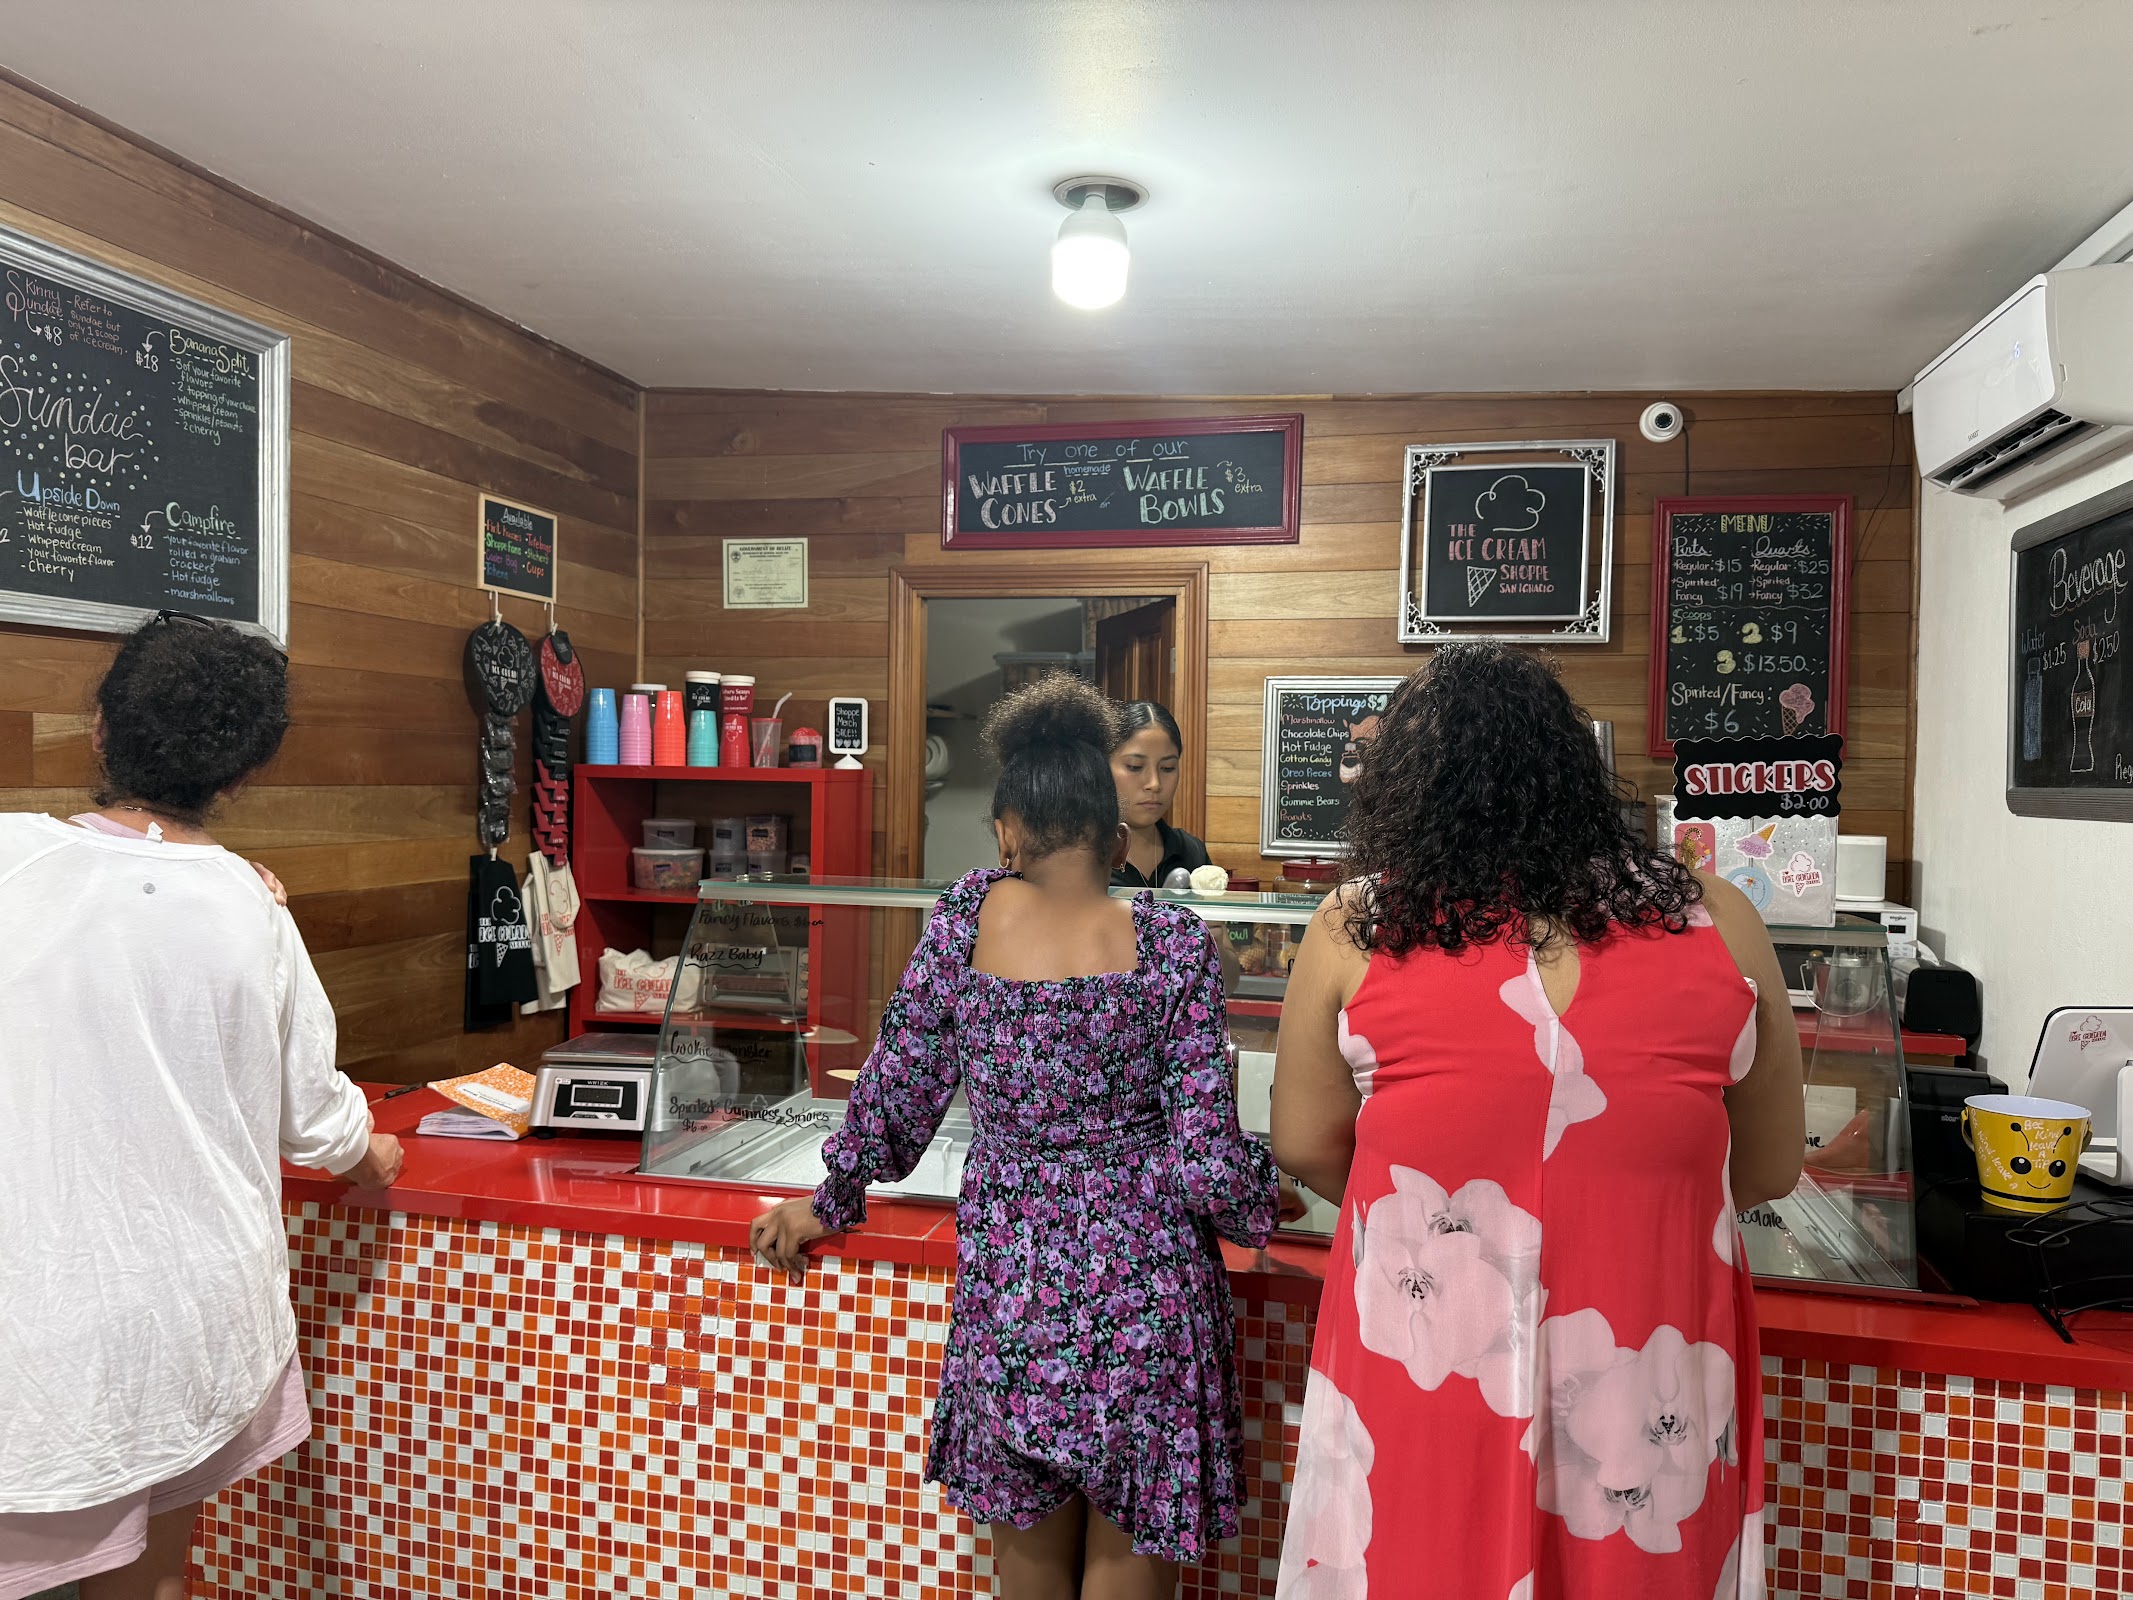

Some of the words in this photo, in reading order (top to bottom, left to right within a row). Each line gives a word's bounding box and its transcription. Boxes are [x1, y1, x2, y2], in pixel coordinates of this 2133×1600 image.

[75, 295, 101, 312] Refer
[103, 302, 113, 317] to
[107, 319, 121, 332] but
[44, 325, 62, 346] $8
[69, 331, 80, 341] of
[95, 331, 119, 343] scoop
[170, 329, 218, 356] Banana
[216, 345, 249, 374] Split
[136, 350, 159, 373] $18
[175, 357, 182, 370] 3
[183, 361, 193, 372] of
[193, 365, 210, 378] your
[210, 369, 241, 388] favorite
[181, 371, 214, 389] flavors
[0, 355, 144, 441] Sundae
[178, 382, 184, 392] 2
[187, 387, 218, 407] topping
[212, 405, 238, 419] cream
[184, 421, 191, 431] 2
[191, 423, 221, 446] cherry
[65, 432, 134, 476] bar
[1017, 443, 1047, 465] Try
[1065, 444, 1099, 459] one
[1116, 439, 1138, 458] of
[1152, 439, 1189, 457] our
[1064, 463, 1112, 476] homemade
[1224, 466, 1246, 482] $3
[18, 469, 83, 507] Upside
[86, 488, 121, 511] Down
[968, 470, 1058, 500] WAFFLE
[1123, 464, 1209, 492] WAFFLE
[1069, 480, 1084, 494] $2
[1235, 481, 1263, 495] extra
[1073, 493, 1098, 504] extra
[981, 498, 1058, 529] CONES
[1099, 500, 1111, 509] or
[1139, 488, 1226, 525] BOWLS
[23, 506, 57, 523] Waffle
[81, 515, 112, 530] pieces
[166, 502, 236, 536] Campfire
[1720, 514, 1774, 533] MENU
[27, 519, 45, 531] Hot
[48, 522, 83, 542] fudge
[1447, 523, 1477, 538] THE
[71, 541, 103, 554] cream
[130, 534, 154, 550] $12
[167, 534, 188, 547] your
[1448, 540, 1474, 561] ICE
[1481, 537, 1547, 561] CREAM
[169, 548, 197, 560] rolled
[201, 551, 209, 560] in
[210, 551, 241, 566] graham
[526, 564, 545, 579] Cups
[1500, 564, 1550, 581] SHOPPE
[1715, 558, 1742, 574] $15
[1798, 559, 1830, 575] $25
[171, 570, 189, 582] Hot
[191, 572, 221, 592] fudge
[1499, 583, 1517, 594] SAN
[1519, 582, 1555, 594] IGNACIO
[1756, 577, 1791, 590] Spirited
[2048, 547, 2129, 624] Beverage
[170, 588, 235, 606] marshmallows
[1675, 590, 1704, 605] Fancy
[1756, 590, 1784, 605] Fancy
[1717, 583, 1743, 601] $19
[1787, 583, 1824, 600] $32
[1672, 608, 1713, 624] Scoops
[1695, 624, 1720, 643] $5
[1771, 621, 1798, 645] $9
[2021, 623, 2046, 655] Water
[2072, 616, 2098, 646] Soda
[2042, 642, 2067, 671] $1.25
[2092, 630, 2121, 665] $2.50
[1743, 652, 1808, 675] $13.50
[1300, 694, 1366, 716] Toppings
[2075, 697, 2092, 714] Cola
[836, 707, 859, 722] Shoppe
[837, 717, 857, 729] Merch
[1705, 708, 1740, 734] $6
[1281, 728, 1326, 739] Chocolate
[1327, 727, 1350, 741] Chips
[1282, 741, 1302, 752] Hot
[1304, 741, 1333, 756] Fudge
[1280, 754, 1308, 764] Cotton
[1310, 755, 1332, 767] Candy
[1282, 768, 1305, 778] Oreo
[1306, 767, 1333, 778] Pieces
[1685, 760, 1836, 796] STICKERS
[1280, 780, 1320, 795] Sprinkles
[1281, 797, 1315, 807] Gummie
[1317, 796, 1340, 806] Bears
[1780, 792, 1830, 811] $2.00
[1280, 809, 1313, 821] Peanuts
[698, 909, 740, 931] Fancy
[690, 943, 726, 961] Razz
[728, 947, 764, 966] Baby
[671, 1031, 713, 1057] Cookie
